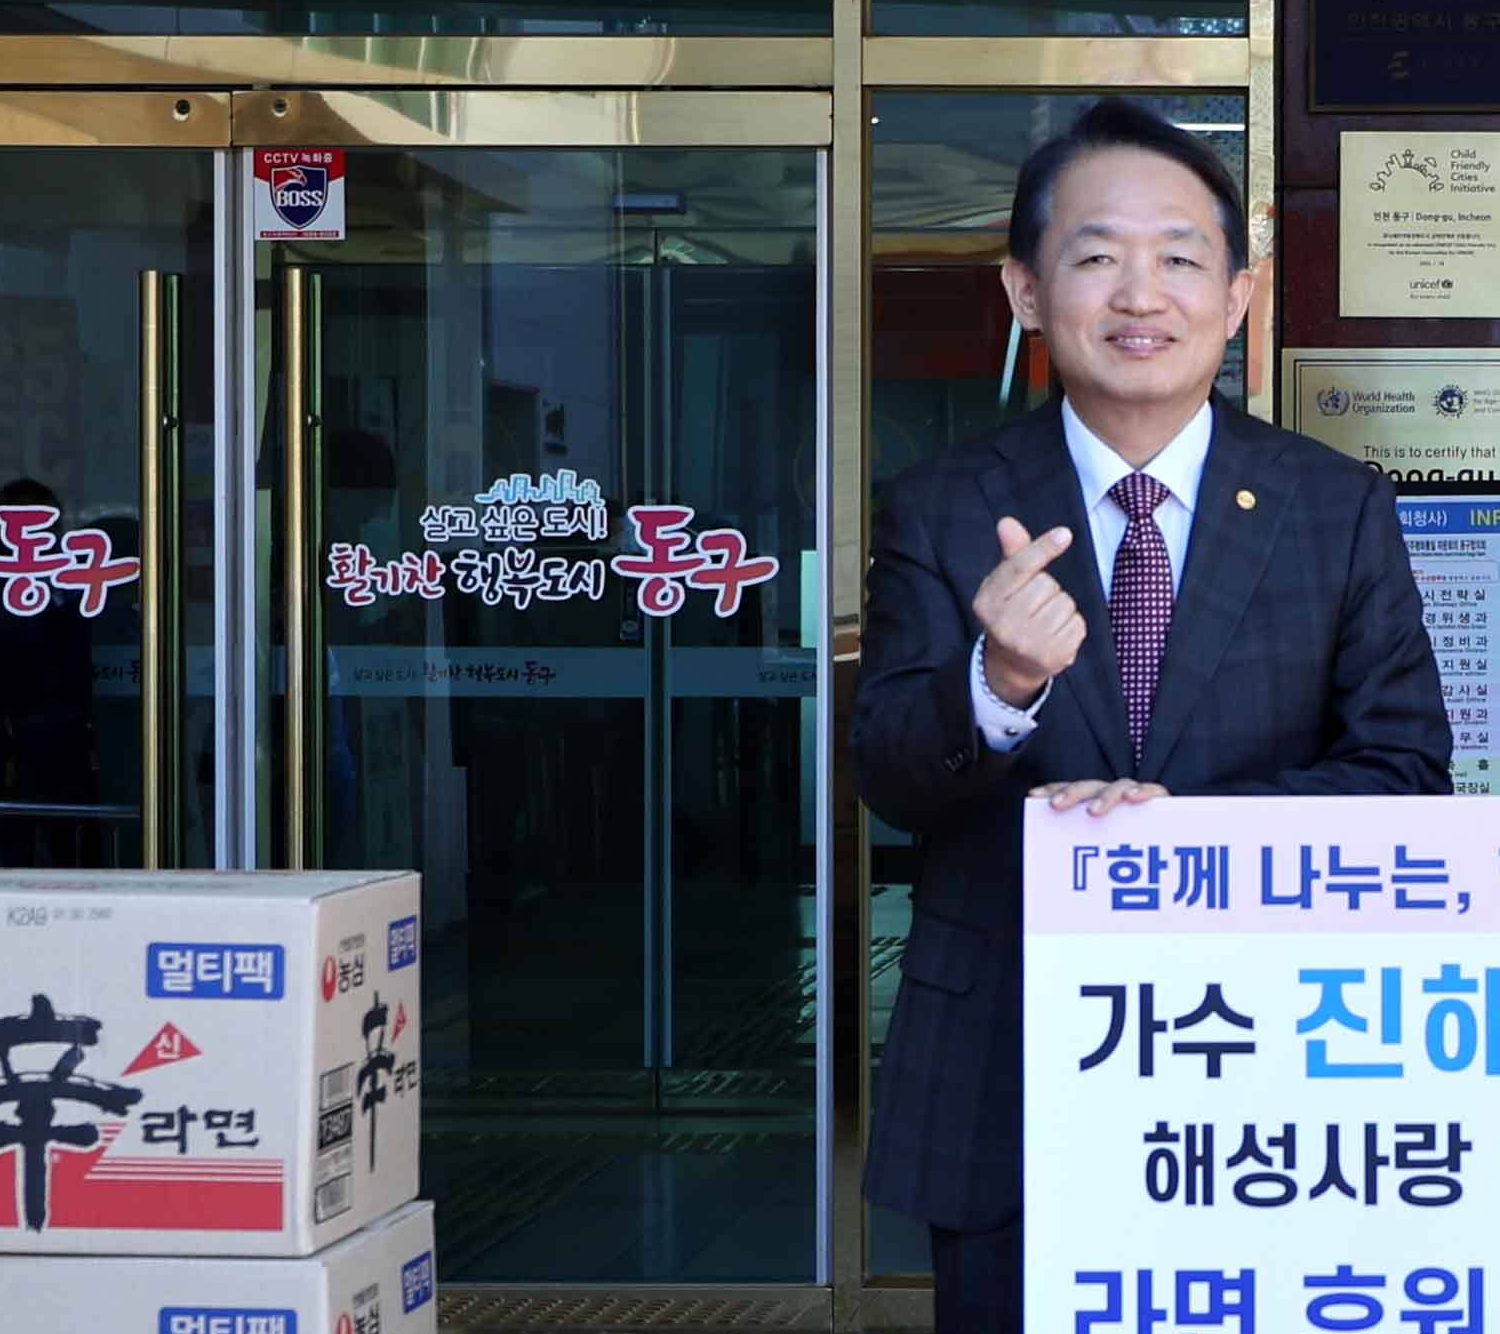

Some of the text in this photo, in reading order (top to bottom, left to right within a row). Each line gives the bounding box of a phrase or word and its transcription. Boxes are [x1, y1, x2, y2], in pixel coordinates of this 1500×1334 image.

[264, 154, 299, 163] CCTV
[1451, 150, 1476, 158] Child
[1451, 162, 1490, 172] Friendly
[1451, 173, 1478, 181] Cities
[1451, 184, 1495, 192] Initiative
[277, 190, 323, 207] BOSS
[1409, 279, 1440, 289] unicef
[1352, 392, 1415, 402] World Health
[1352, 404, 1415, 416] Organization
[1364, 445, 1496, 461] This is to certify that
[420, 505, 608, 542] 살고 싶은 도시!
[327, 505, 779, 617] 활기찬 행복도시 동구
[1259, 844, 1472, 915] 나누는,
[1077, 982, 1256, 1079] 가수
[1143, 1120, 1473, 1208] 해성사랑
